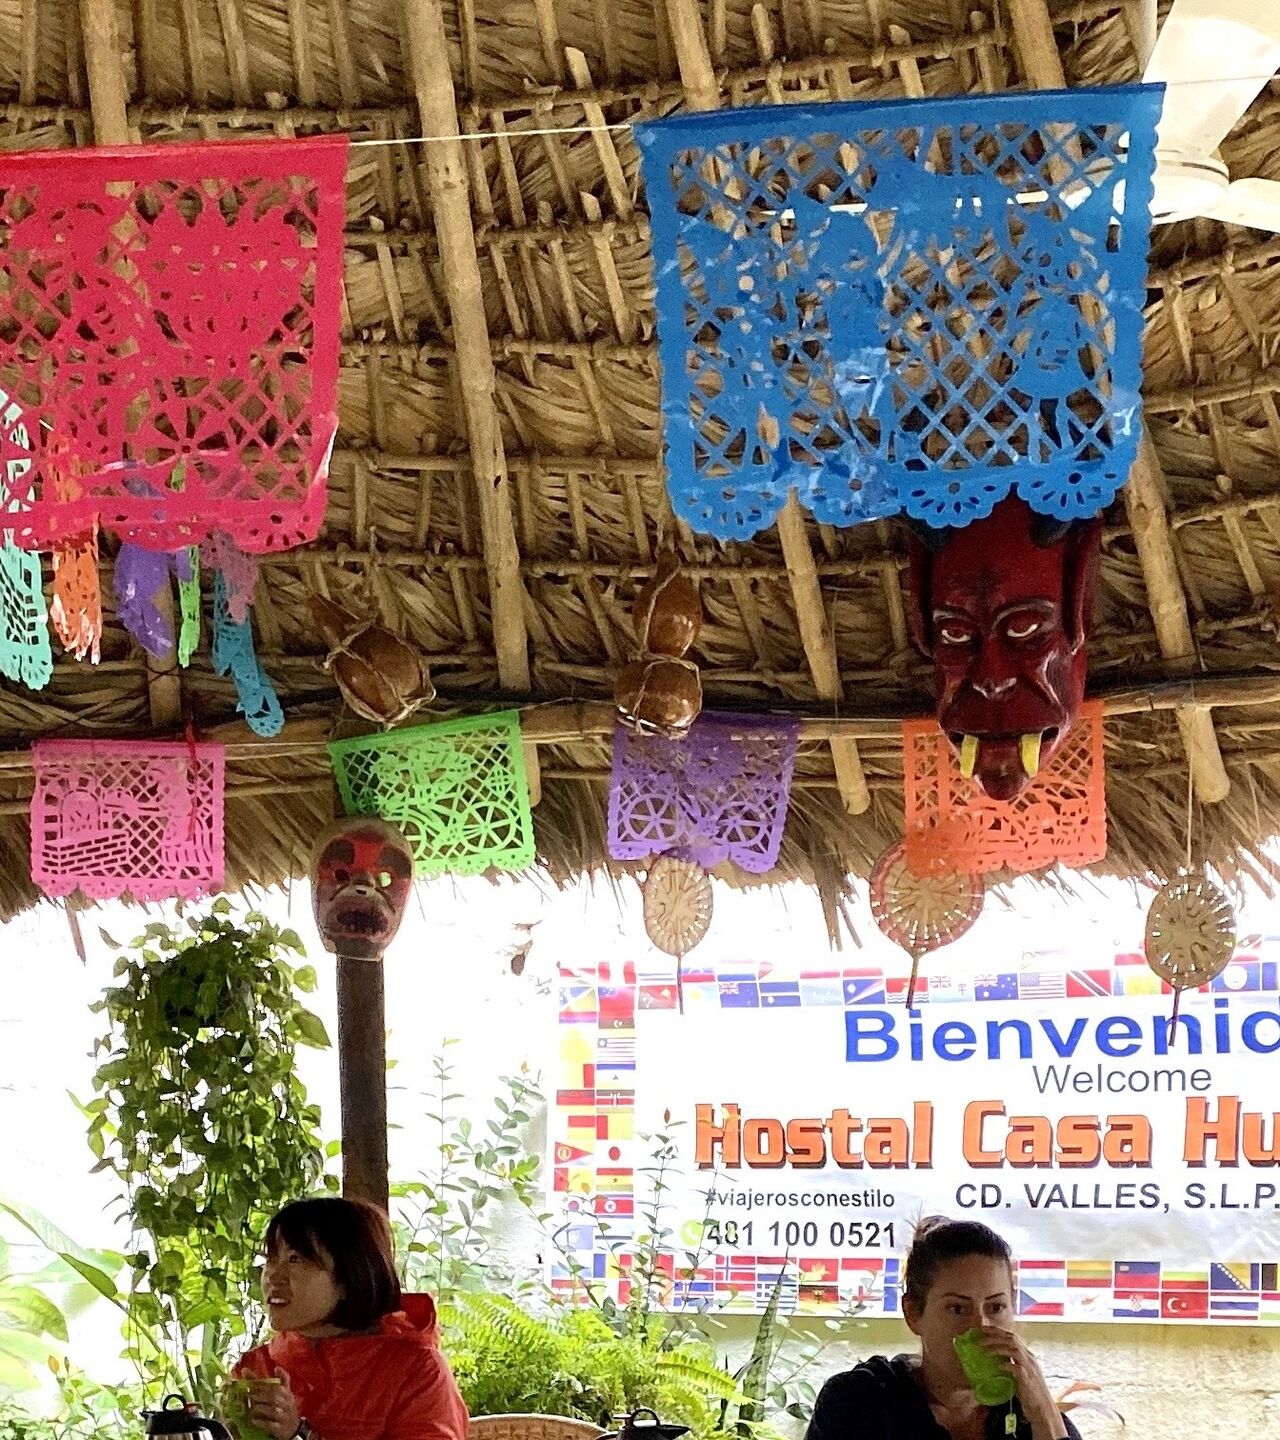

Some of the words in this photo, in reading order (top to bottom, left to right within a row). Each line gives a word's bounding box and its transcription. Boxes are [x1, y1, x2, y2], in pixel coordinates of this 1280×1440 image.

[1032, 1064, 1212, 1093] Welcome
[695, 1101, 934, 1169] Hostal
[962, 1100, 1153, 1169] Casa
[705, 1188, 895, 1210] #viajerosconestilo
[956, 1183, 1012, 1208] CD.
[1024, 1183, 1170, 1213] VALLES,
[1184, 1183, 1280, 1208] S.L.P.
[707, 1220, 753, 1246] 481
[768, 1221, 818, 1246] 100
[830, 1222, 895, 1248] 0521
